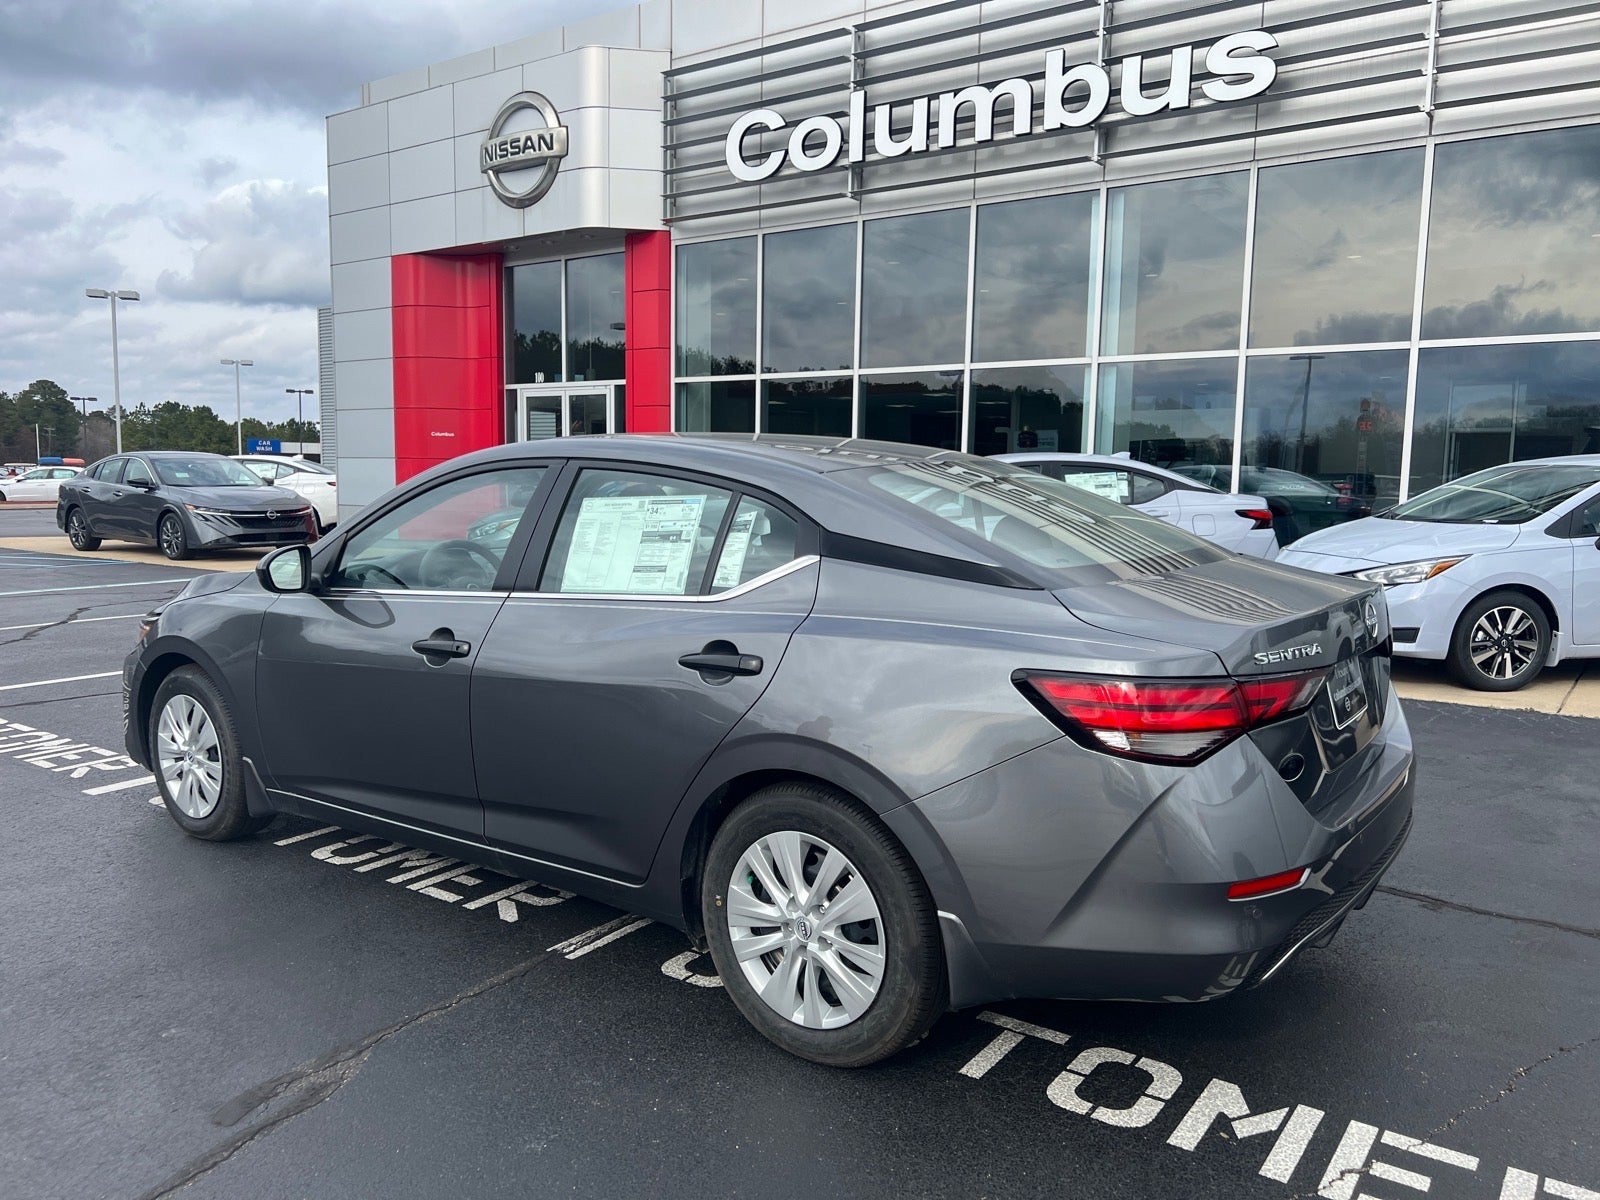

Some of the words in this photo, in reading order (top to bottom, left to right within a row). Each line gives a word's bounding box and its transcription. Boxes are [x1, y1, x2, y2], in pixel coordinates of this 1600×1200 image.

[725, 30, 1279, 182] Columbus
[483, 132, 555, 165] NISSAN
[1253, 643, 1323, 665] SENTRA
[0, 717, 139, 779] TOMER
